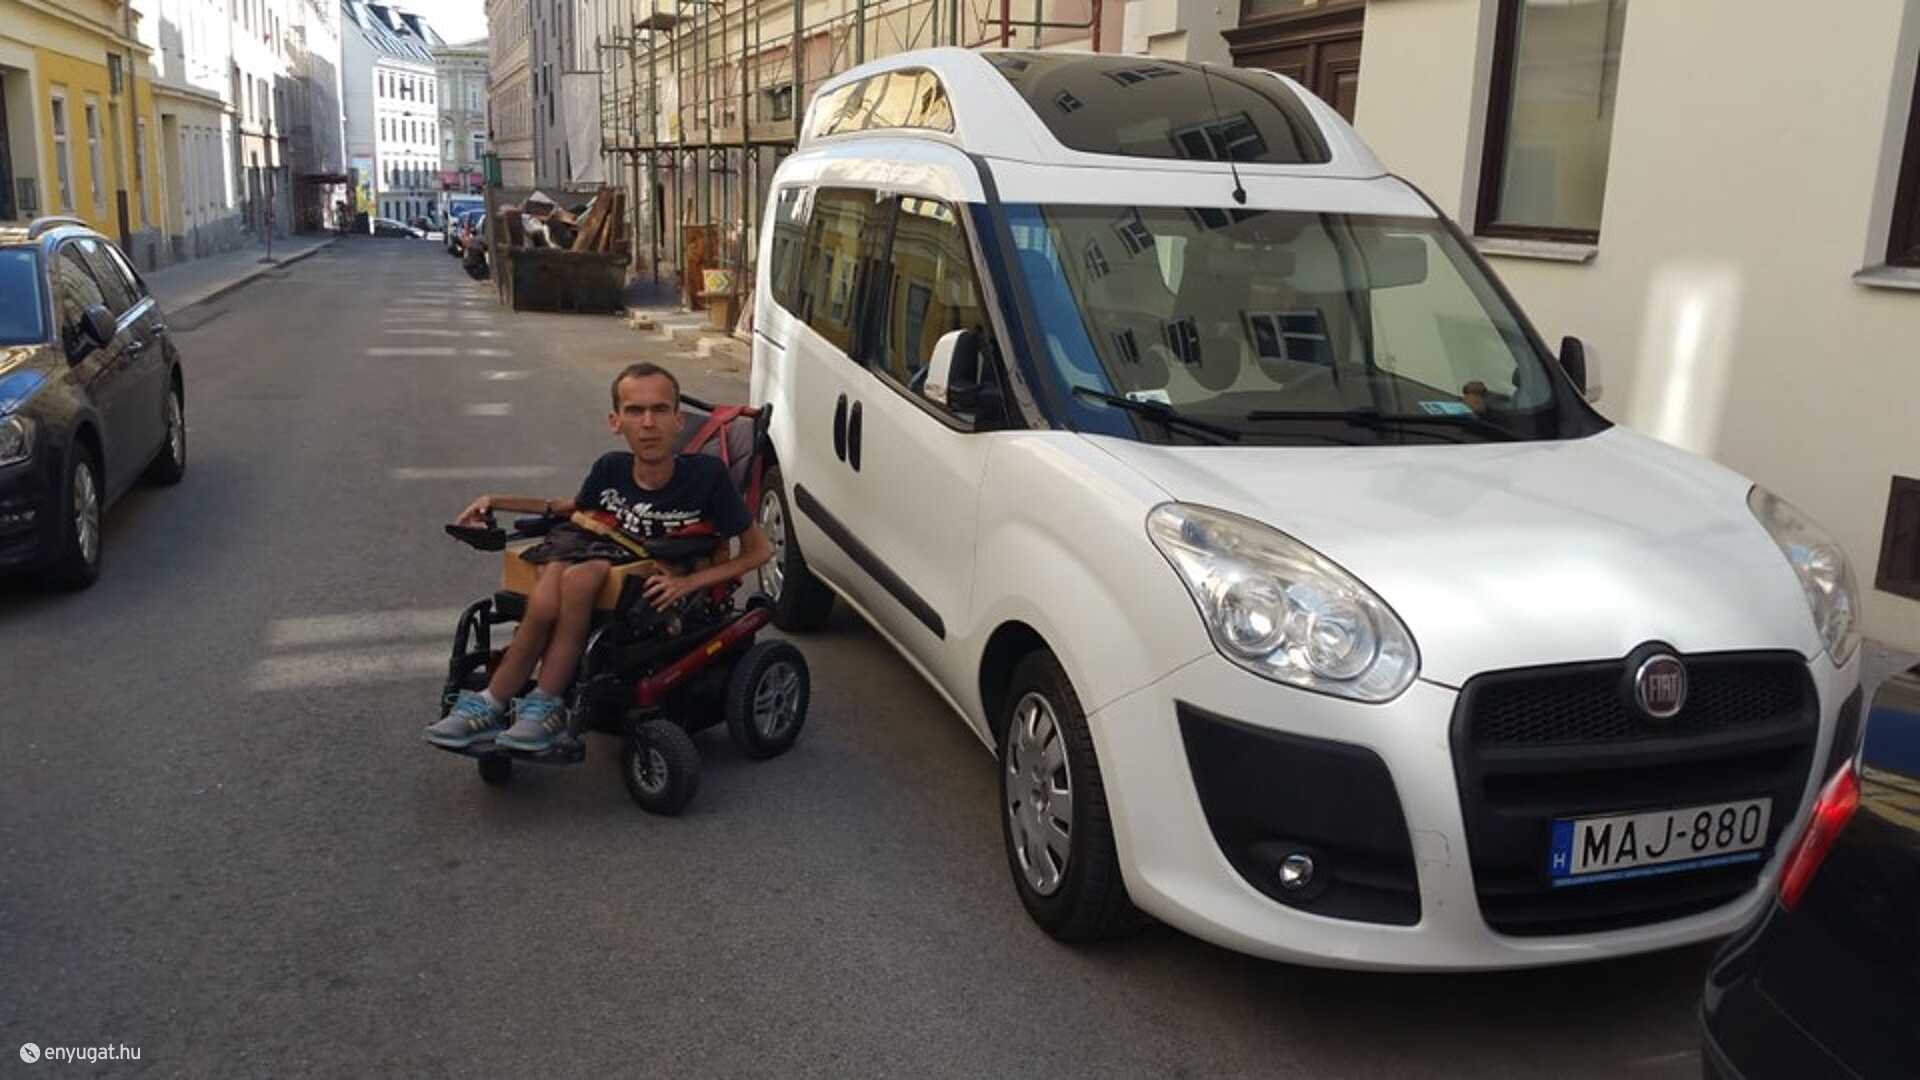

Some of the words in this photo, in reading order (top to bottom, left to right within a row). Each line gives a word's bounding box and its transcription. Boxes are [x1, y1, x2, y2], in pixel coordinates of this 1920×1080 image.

[1649, 673, 1680, 702] FIAT
[1582, 804, 1762, 868] MAJ-880
[1553, 852, 1566, 869] H
